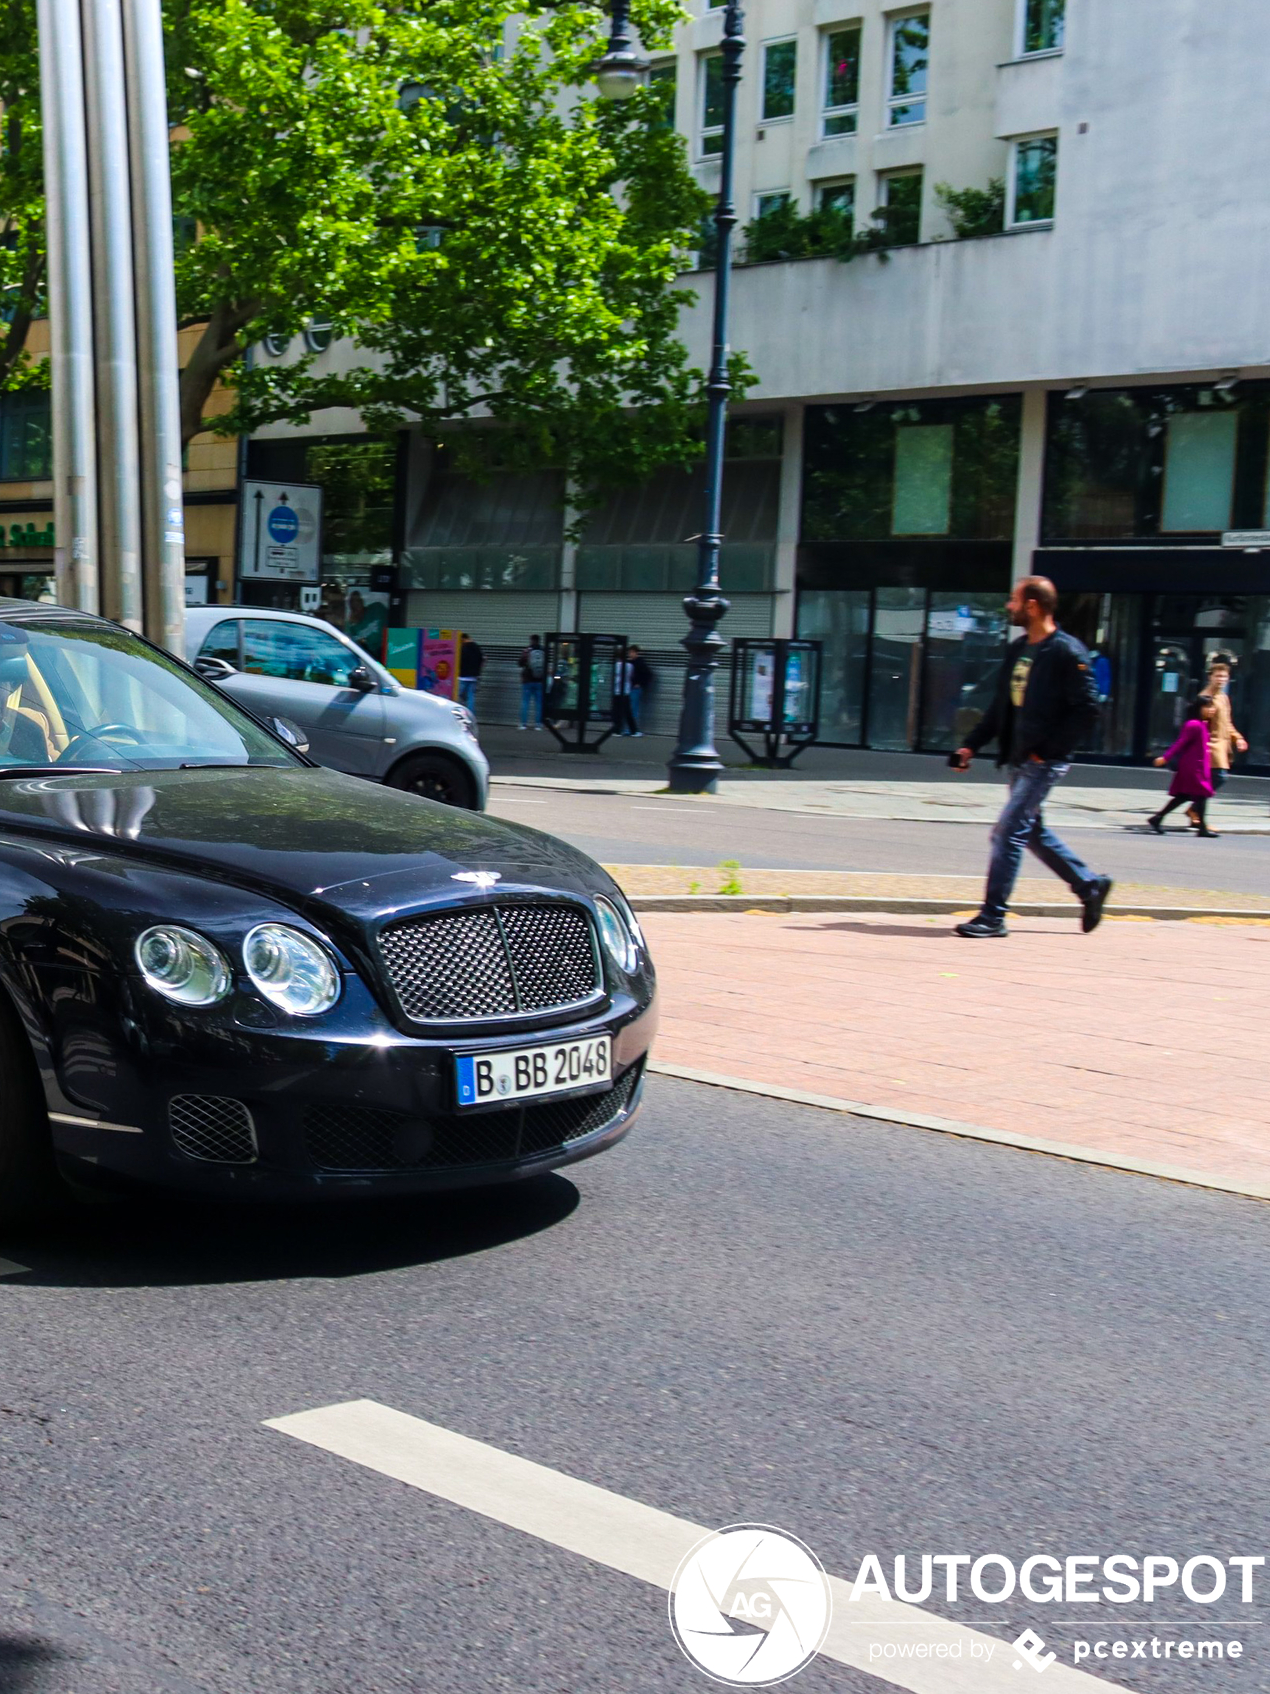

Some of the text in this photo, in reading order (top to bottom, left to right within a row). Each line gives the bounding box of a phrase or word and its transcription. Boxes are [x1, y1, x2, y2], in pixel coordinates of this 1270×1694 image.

[476, 1060, 494, 1096] B
[515, 1052, 548, 1091] BB
[554, 1040, 607, 1084] 2048
